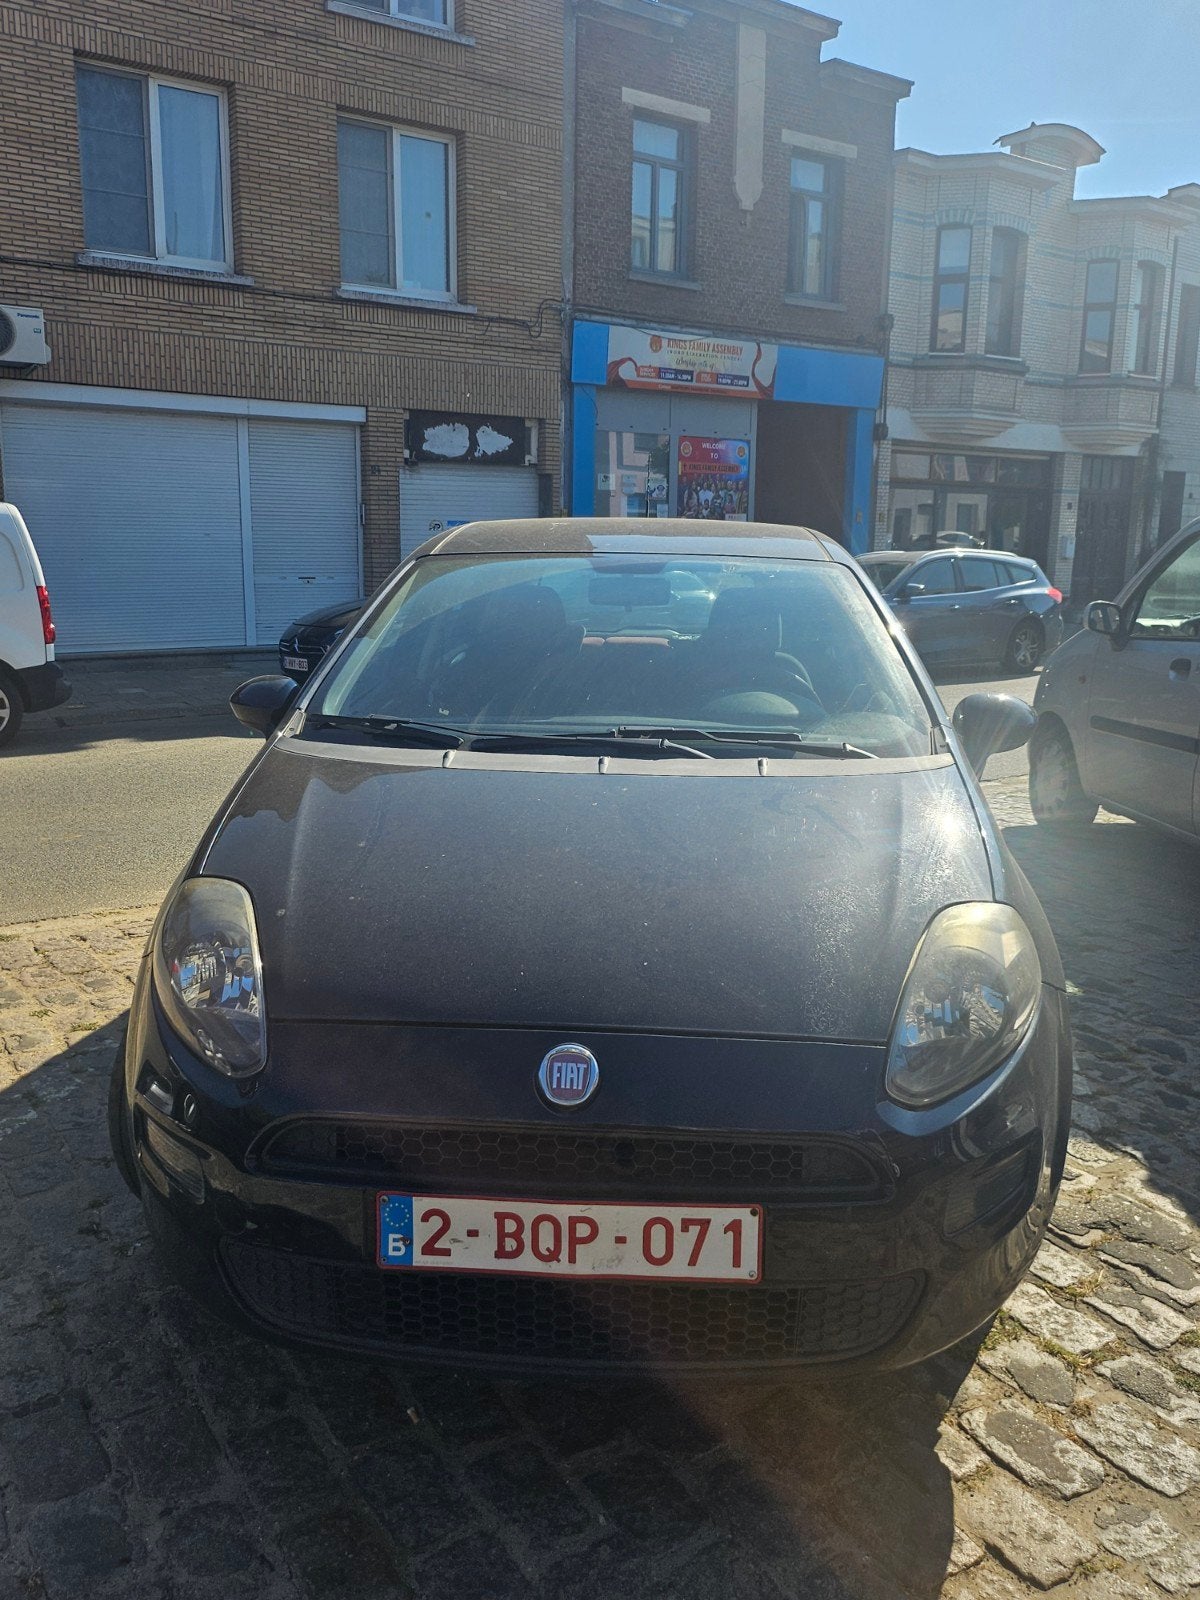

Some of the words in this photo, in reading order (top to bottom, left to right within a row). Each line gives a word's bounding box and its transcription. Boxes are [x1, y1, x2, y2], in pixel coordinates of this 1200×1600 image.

[667, 338, 687, 350] KINGS
[689, 340, 711, 353] FAMILY
[712, 342, 744, 356] ASSEMBLY
[552, 1062, 587, 1090] FIAT
[388, 1233, 406, 1256] B
[420, 1207, 742, 1269] 2-BQP-071
